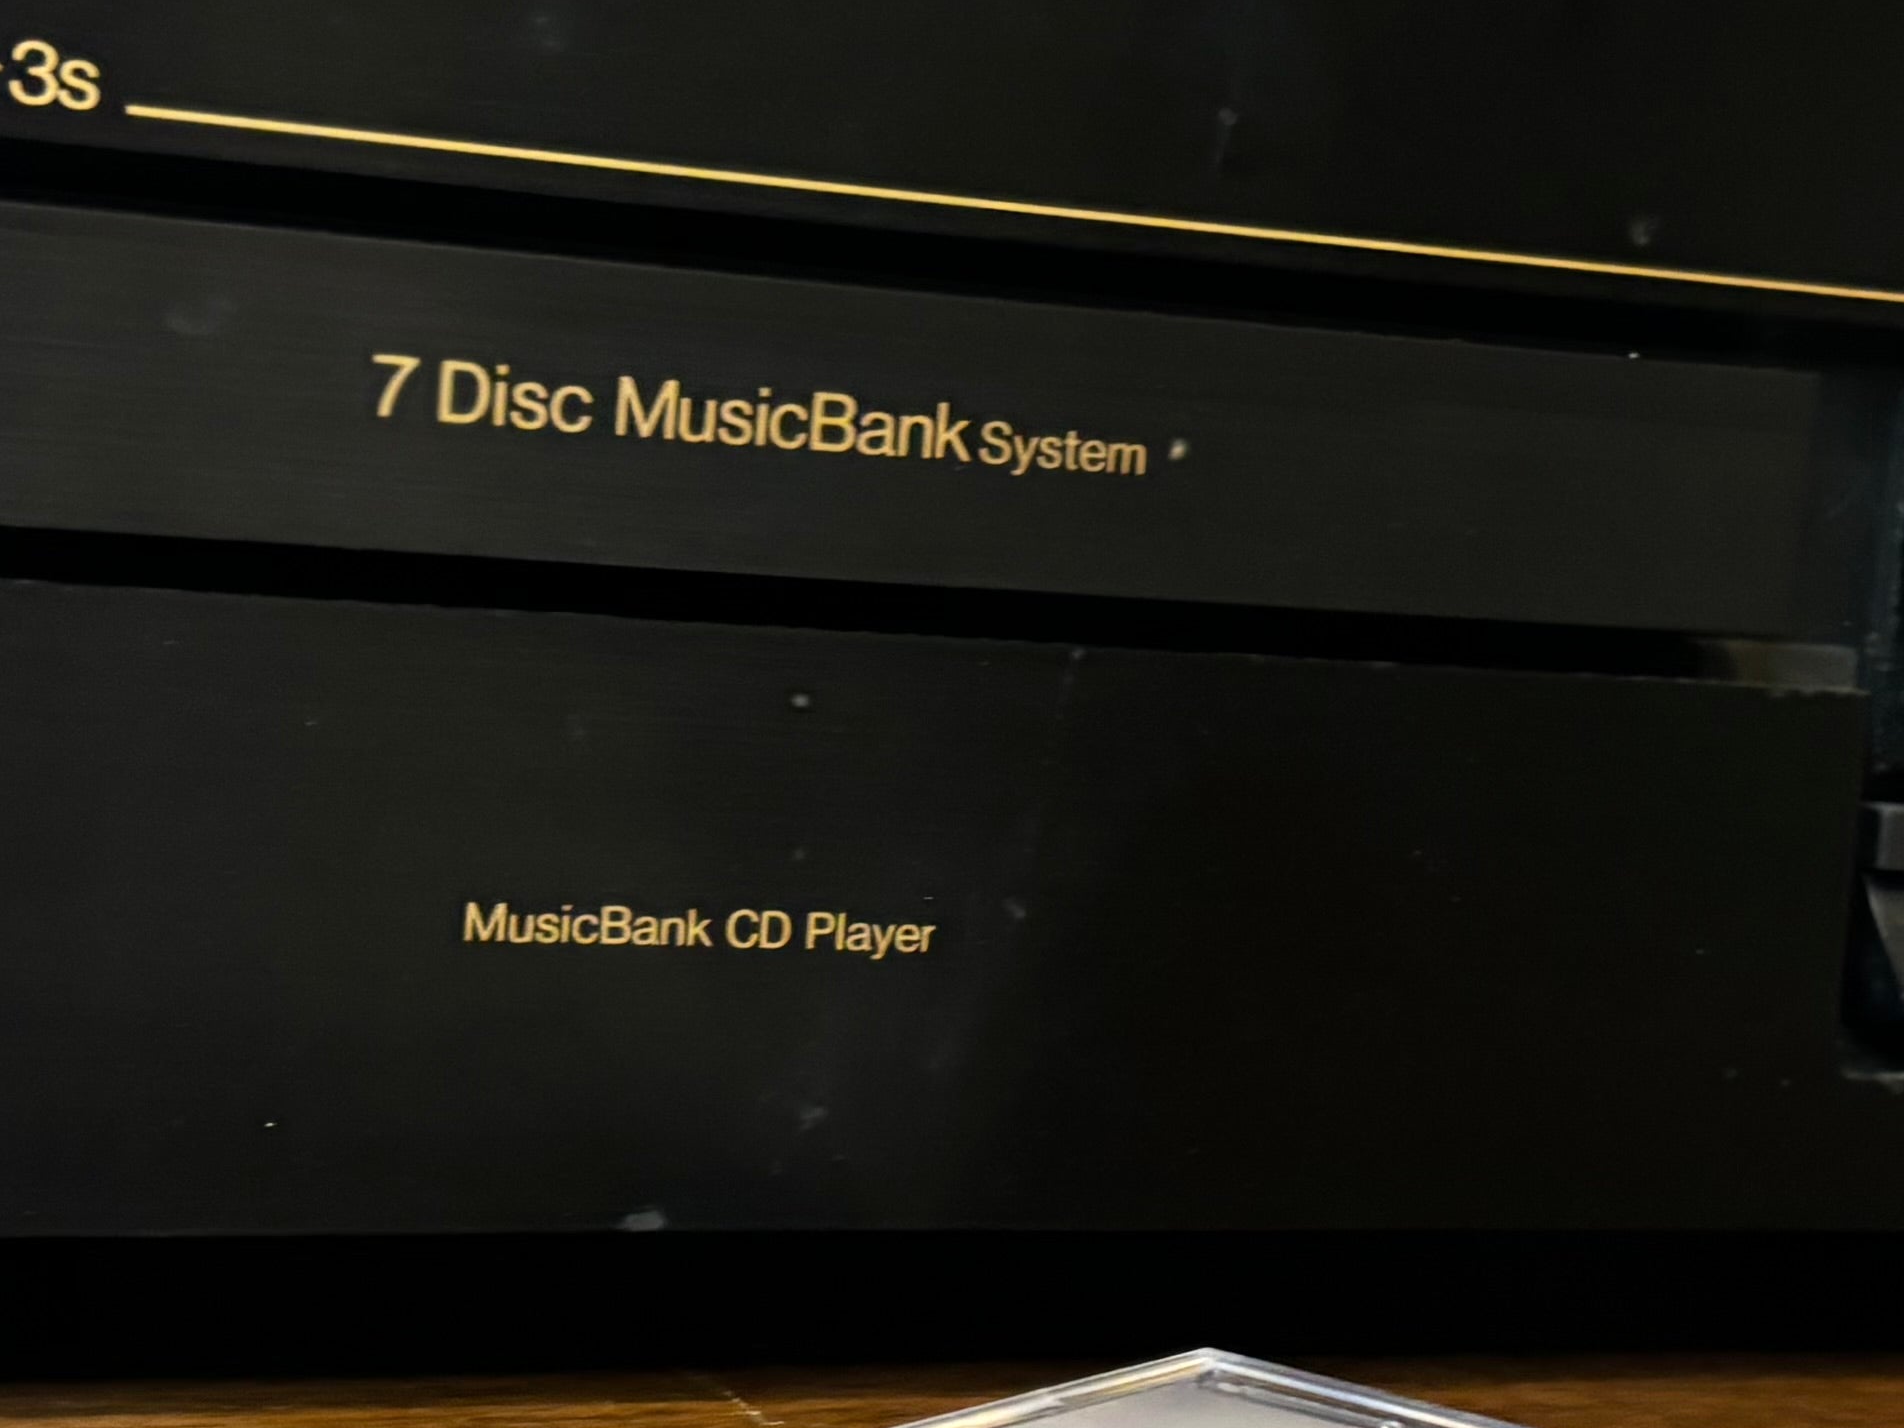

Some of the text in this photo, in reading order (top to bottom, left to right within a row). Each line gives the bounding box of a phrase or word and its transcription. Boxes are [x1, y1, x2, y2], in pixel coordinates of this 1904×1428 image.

[370, 353, 1148, 477] 7 Disc MusicBank System
[462, 901, 937, 960] MusicBank CD Player
